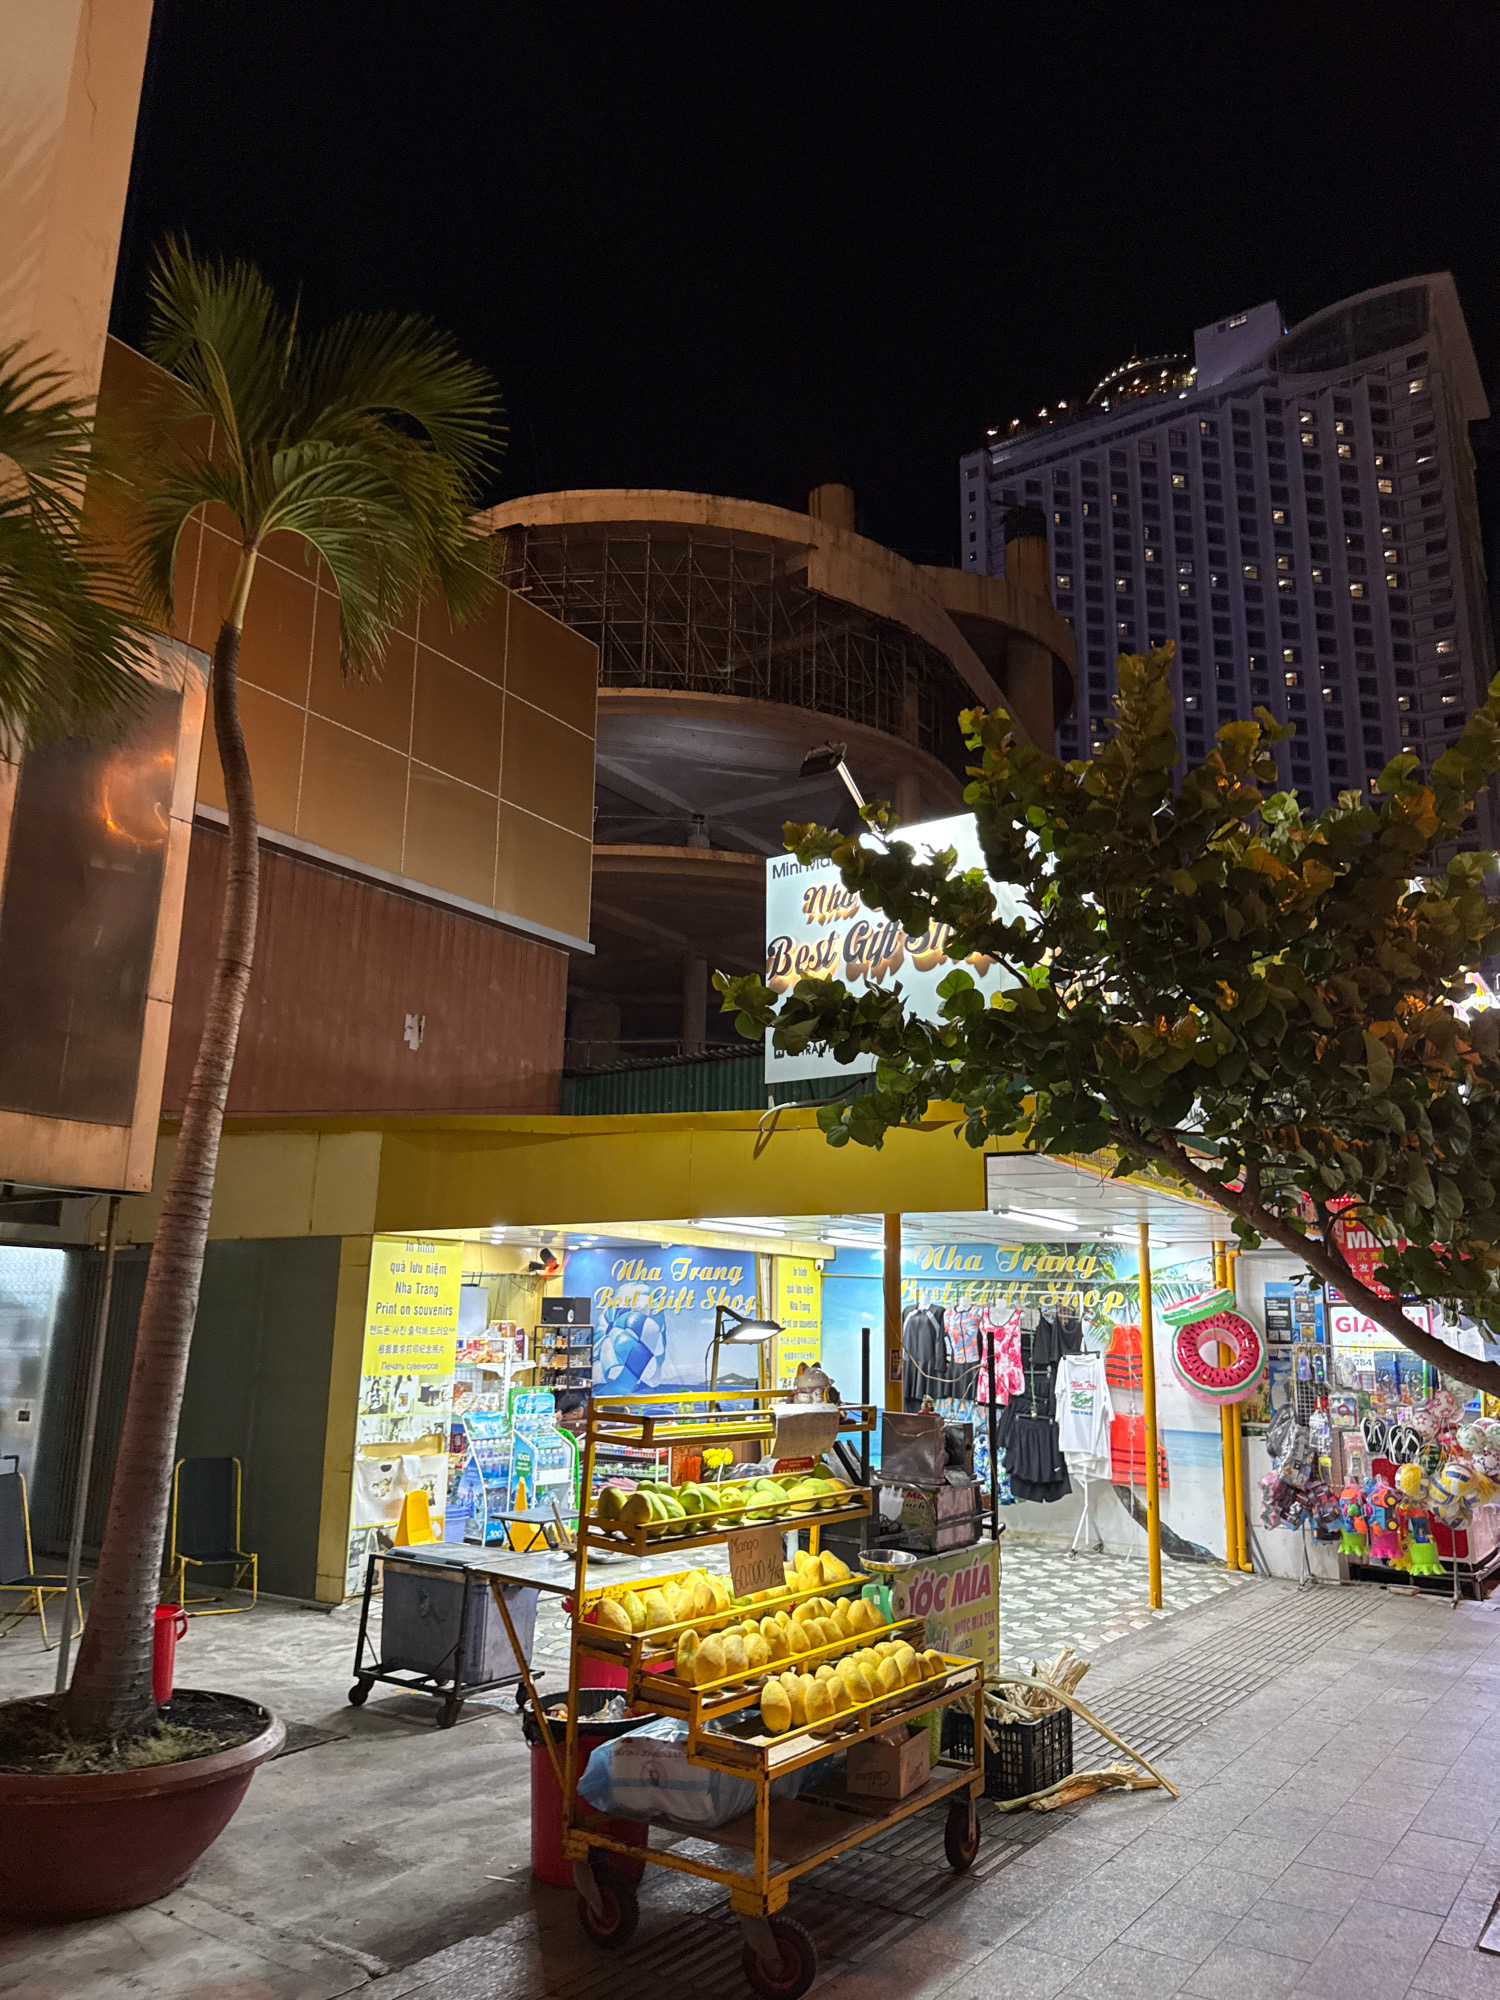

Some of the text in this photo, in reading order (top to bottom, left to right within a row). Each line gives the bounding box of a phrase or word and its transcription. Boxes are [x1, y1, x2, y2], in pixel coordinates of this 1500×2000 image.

[768, 930, 841, 980] Best
[842, 920, 901, 969] Gift
[426, 1262, 447, 1277] niệm
[612, 1257, 744, 1286] Nha Trang
[914, 1245, 1100, 1279] Nha Trang
[395, 1281, 439, 1297] Nha Trang
[594, 1286, 758, 1315] Best Gift Shop
[1039, 1279, 1128, 1314] Shop
[375, 1301, 453, 1316] Print on souvenirs
[381, 1361, 439, 1372] Печать сувениров
[730, 1537, 759, 1558] Mango
[950, 1557, 991, 1608] MÍA
